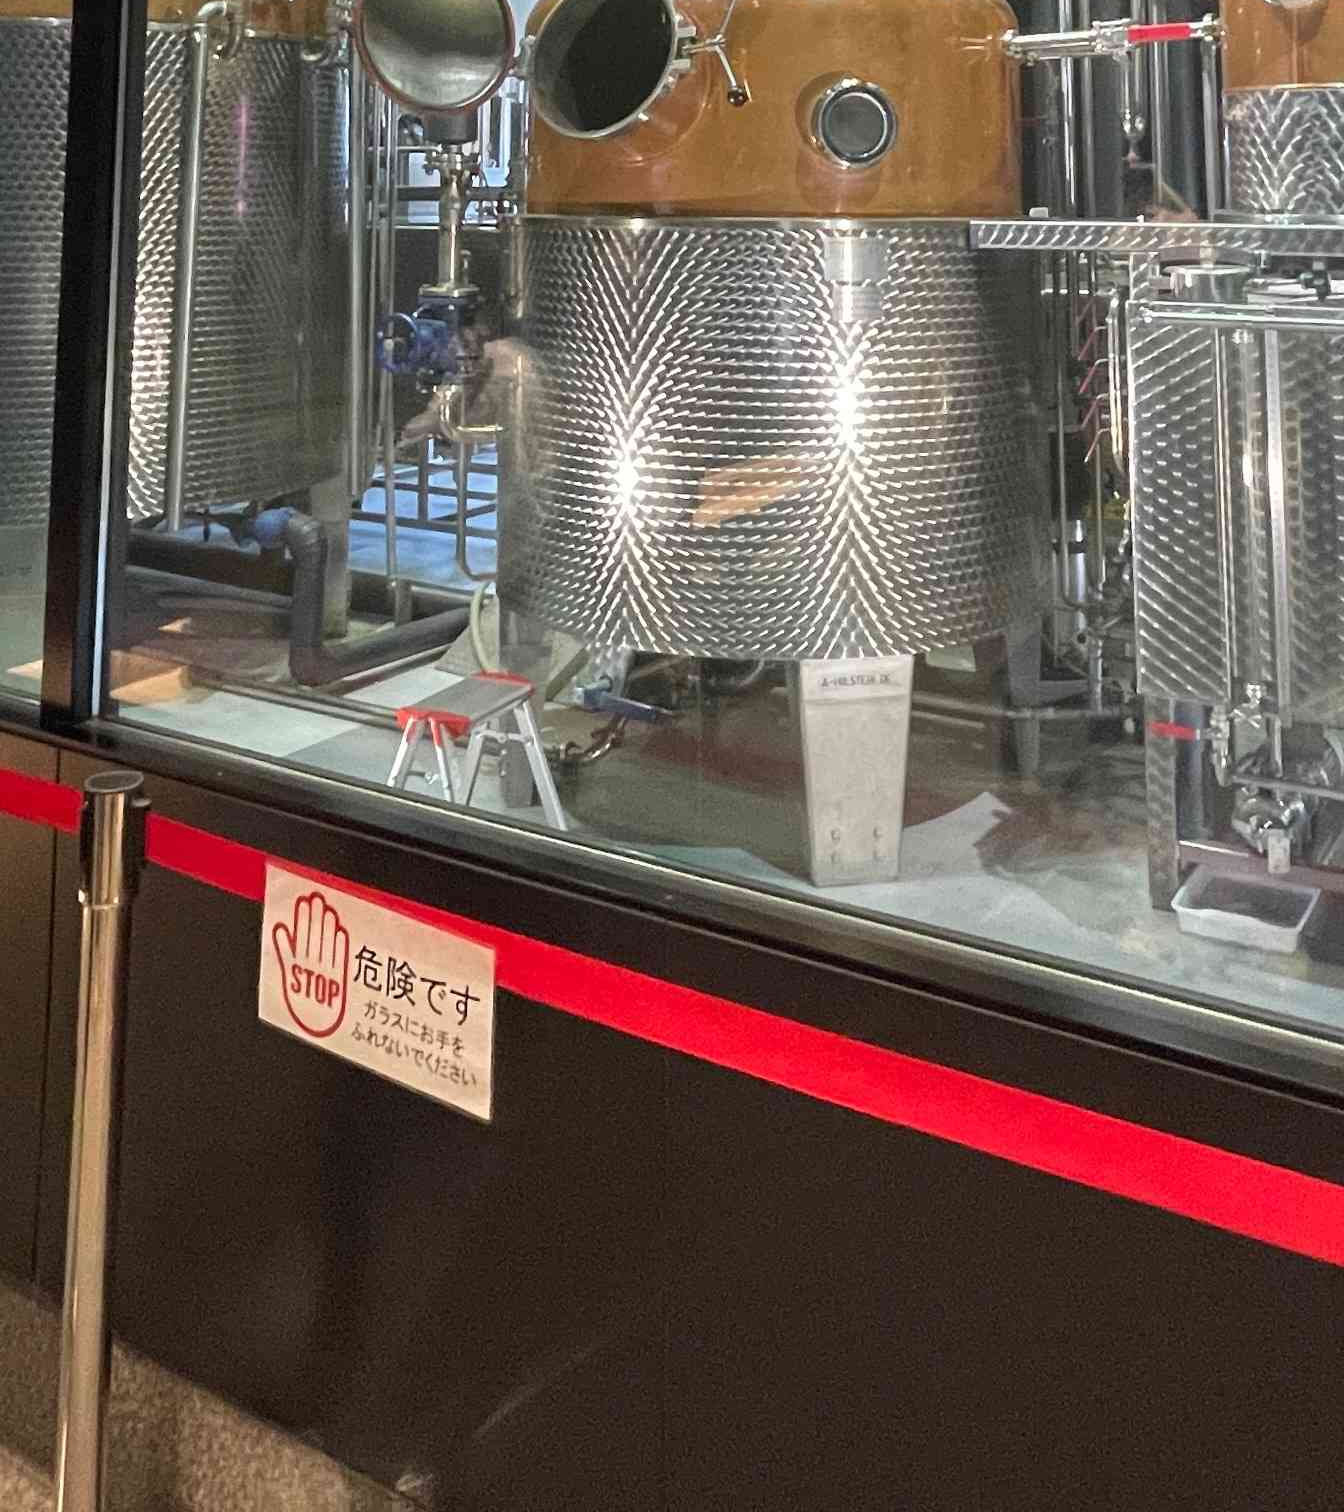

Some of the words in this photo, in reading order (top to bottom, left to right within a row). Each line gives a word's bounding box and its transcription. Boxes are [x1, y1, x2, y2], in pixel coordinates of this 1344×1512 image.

[291, 964, 340, 1008] STOP
[353, 945, 481, 1025] 危険です
[351, 1022, 478, 1086] ふれないでください
[364, 1000, 465, 1058] ガラスにお手を
